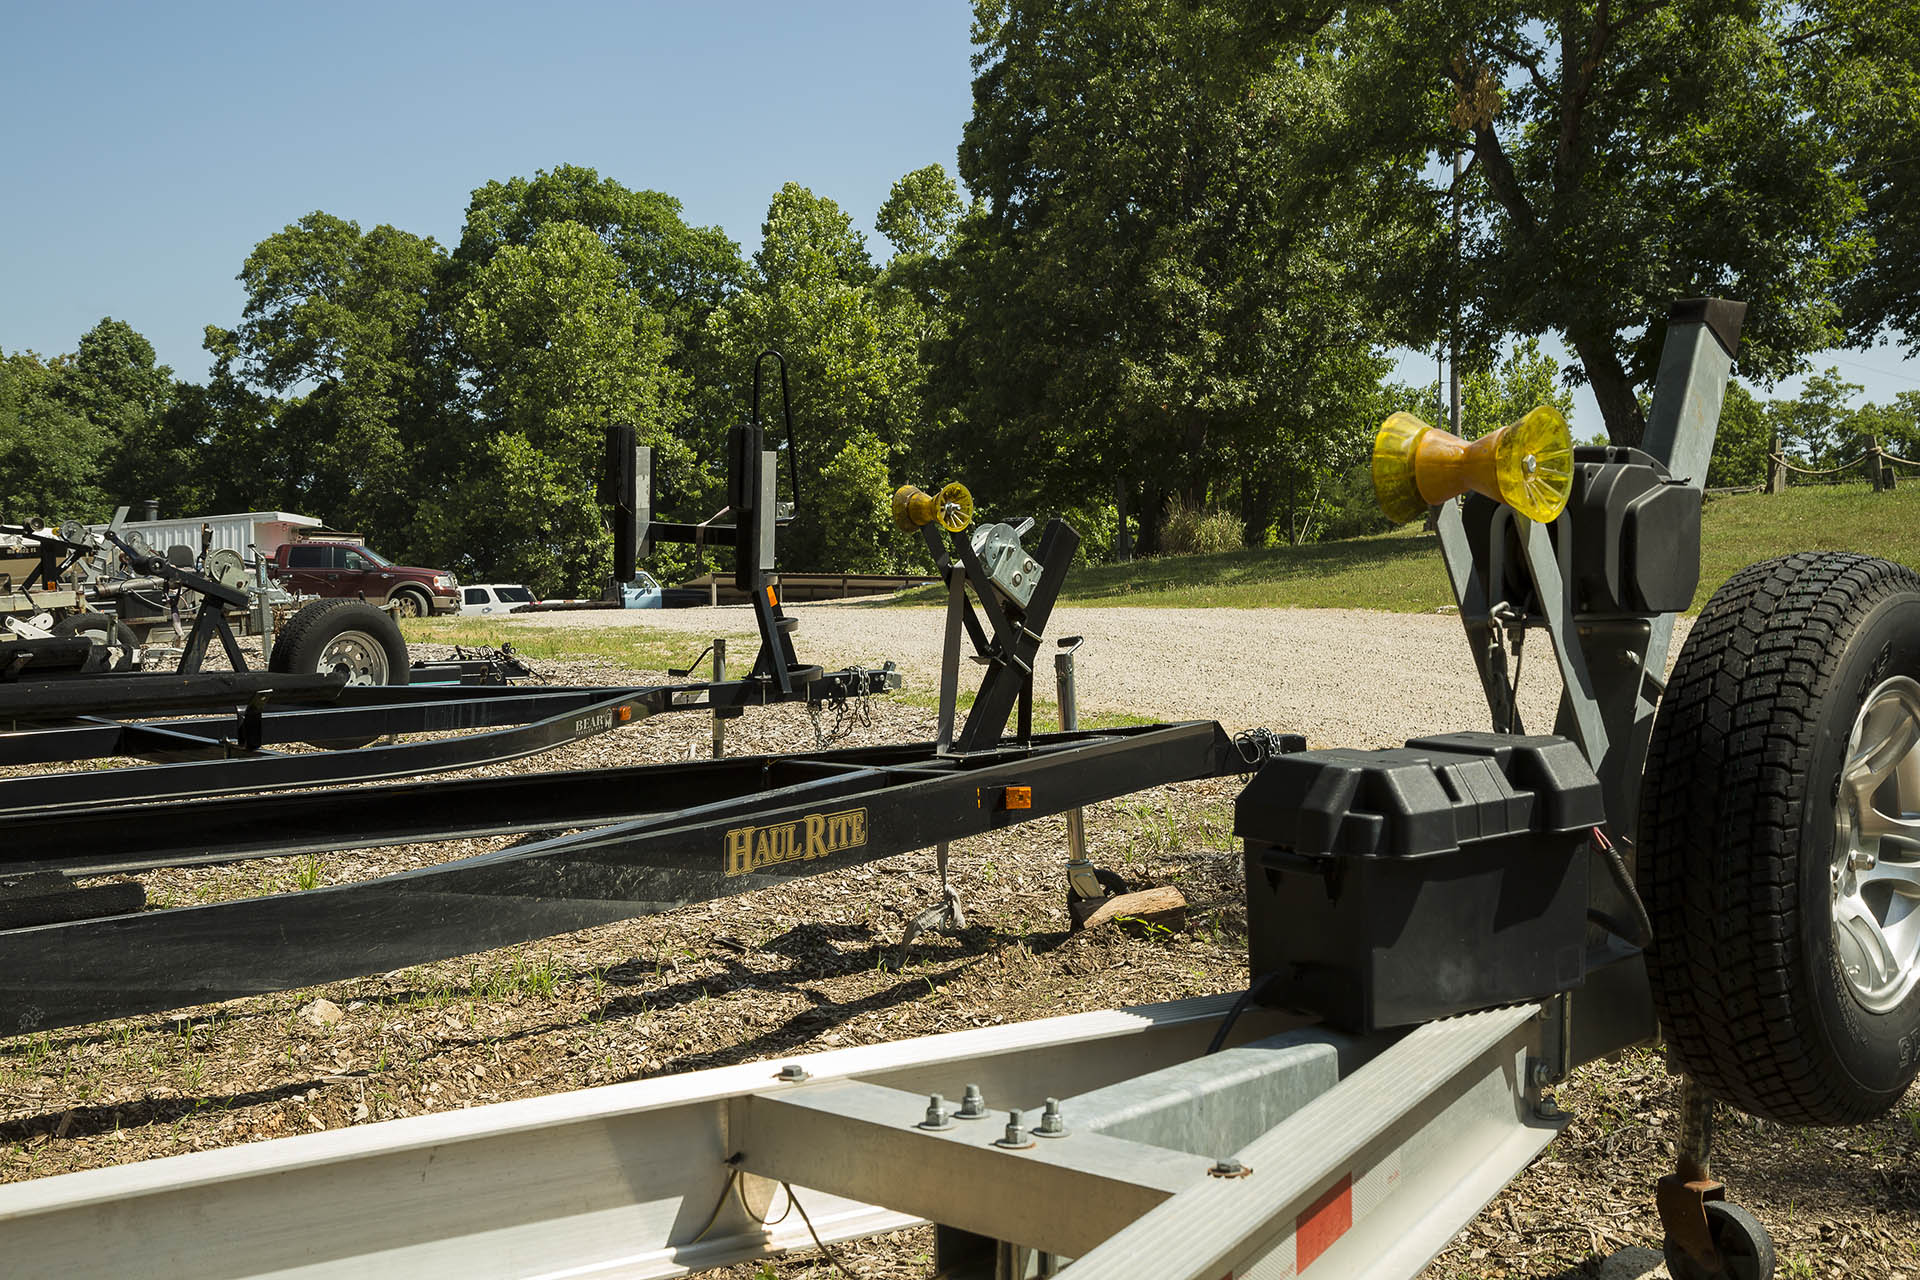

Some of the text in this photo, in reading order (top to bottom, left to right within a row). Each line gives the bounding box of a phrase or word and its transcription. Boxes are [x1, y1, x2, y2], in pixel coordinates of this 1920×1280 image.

[575, 715, 604, 732] BEAR
[726, 812, 866, 877] HAUL RITE
